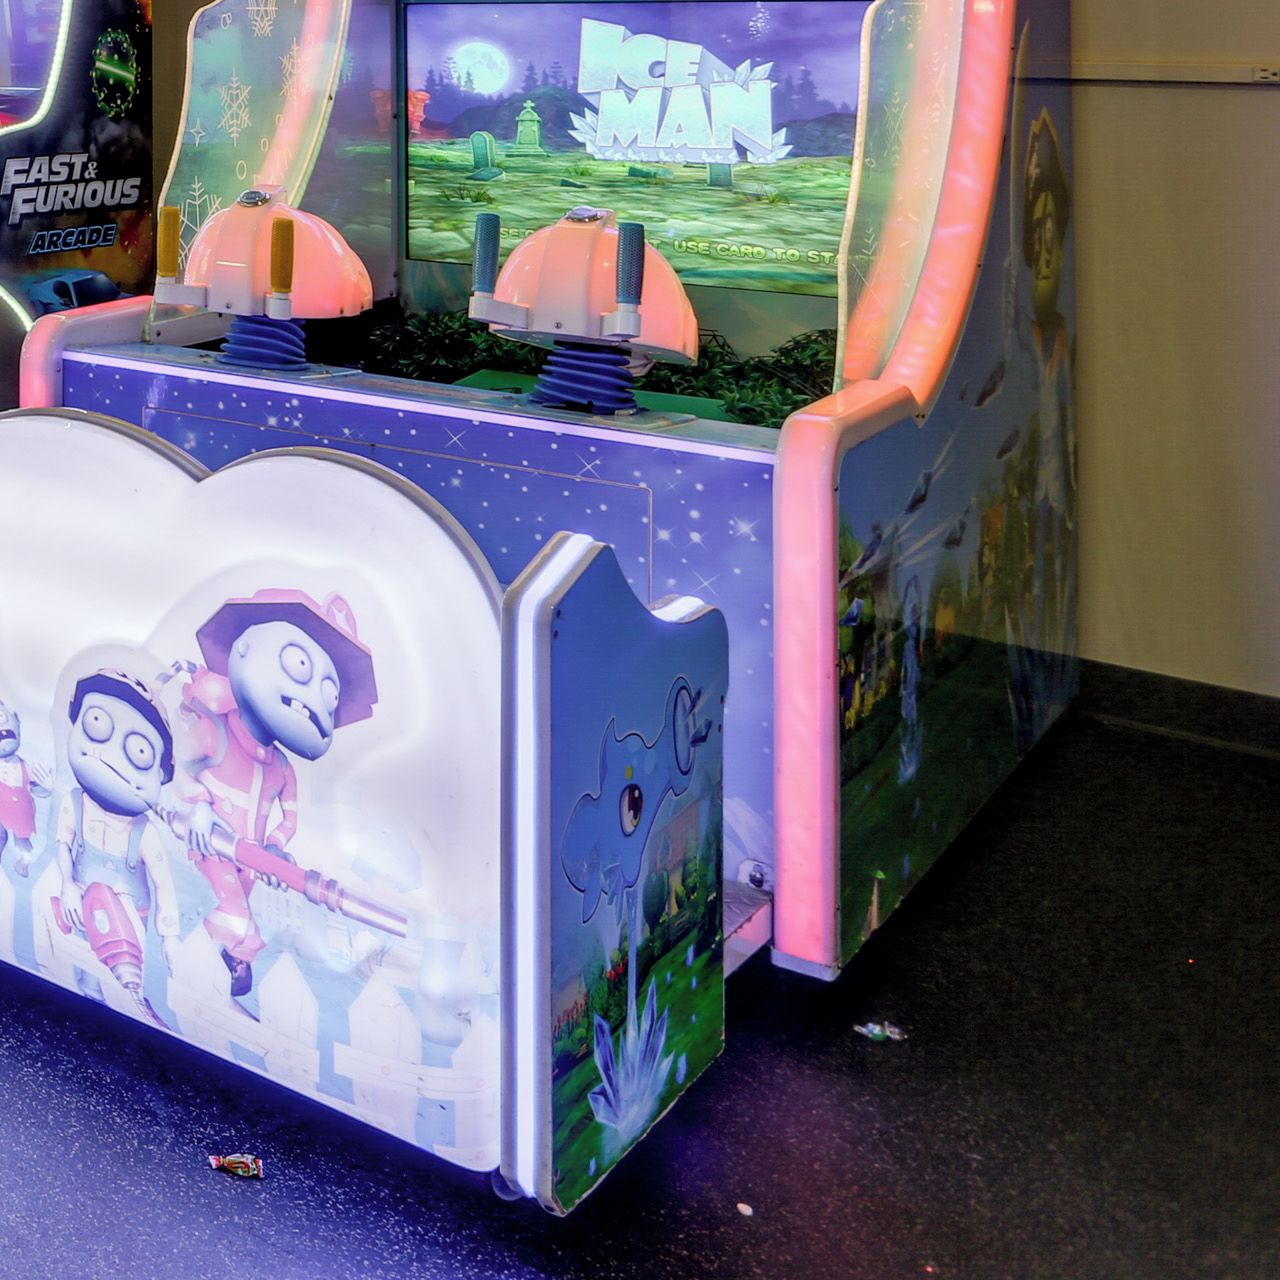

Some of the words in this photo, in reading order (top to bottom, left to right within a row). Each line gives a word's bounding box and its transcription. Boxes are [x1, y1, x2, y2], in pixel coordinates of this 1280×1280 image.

[578, 17, 704, 93] ICE
[596, 78, 773, 151] MAN
[0, 153, 89, 196] FAST
[83, 160, 98, 180] &
[8, 177, 142, 225] FURIOUS
[26, 223, 118, 256] ARCADE
[500, 227, 519, 240] SE
[674, 239, 711, 256] USE
[715, 241, 766, 260] CARD
[772, 247, 802, 263] TO
